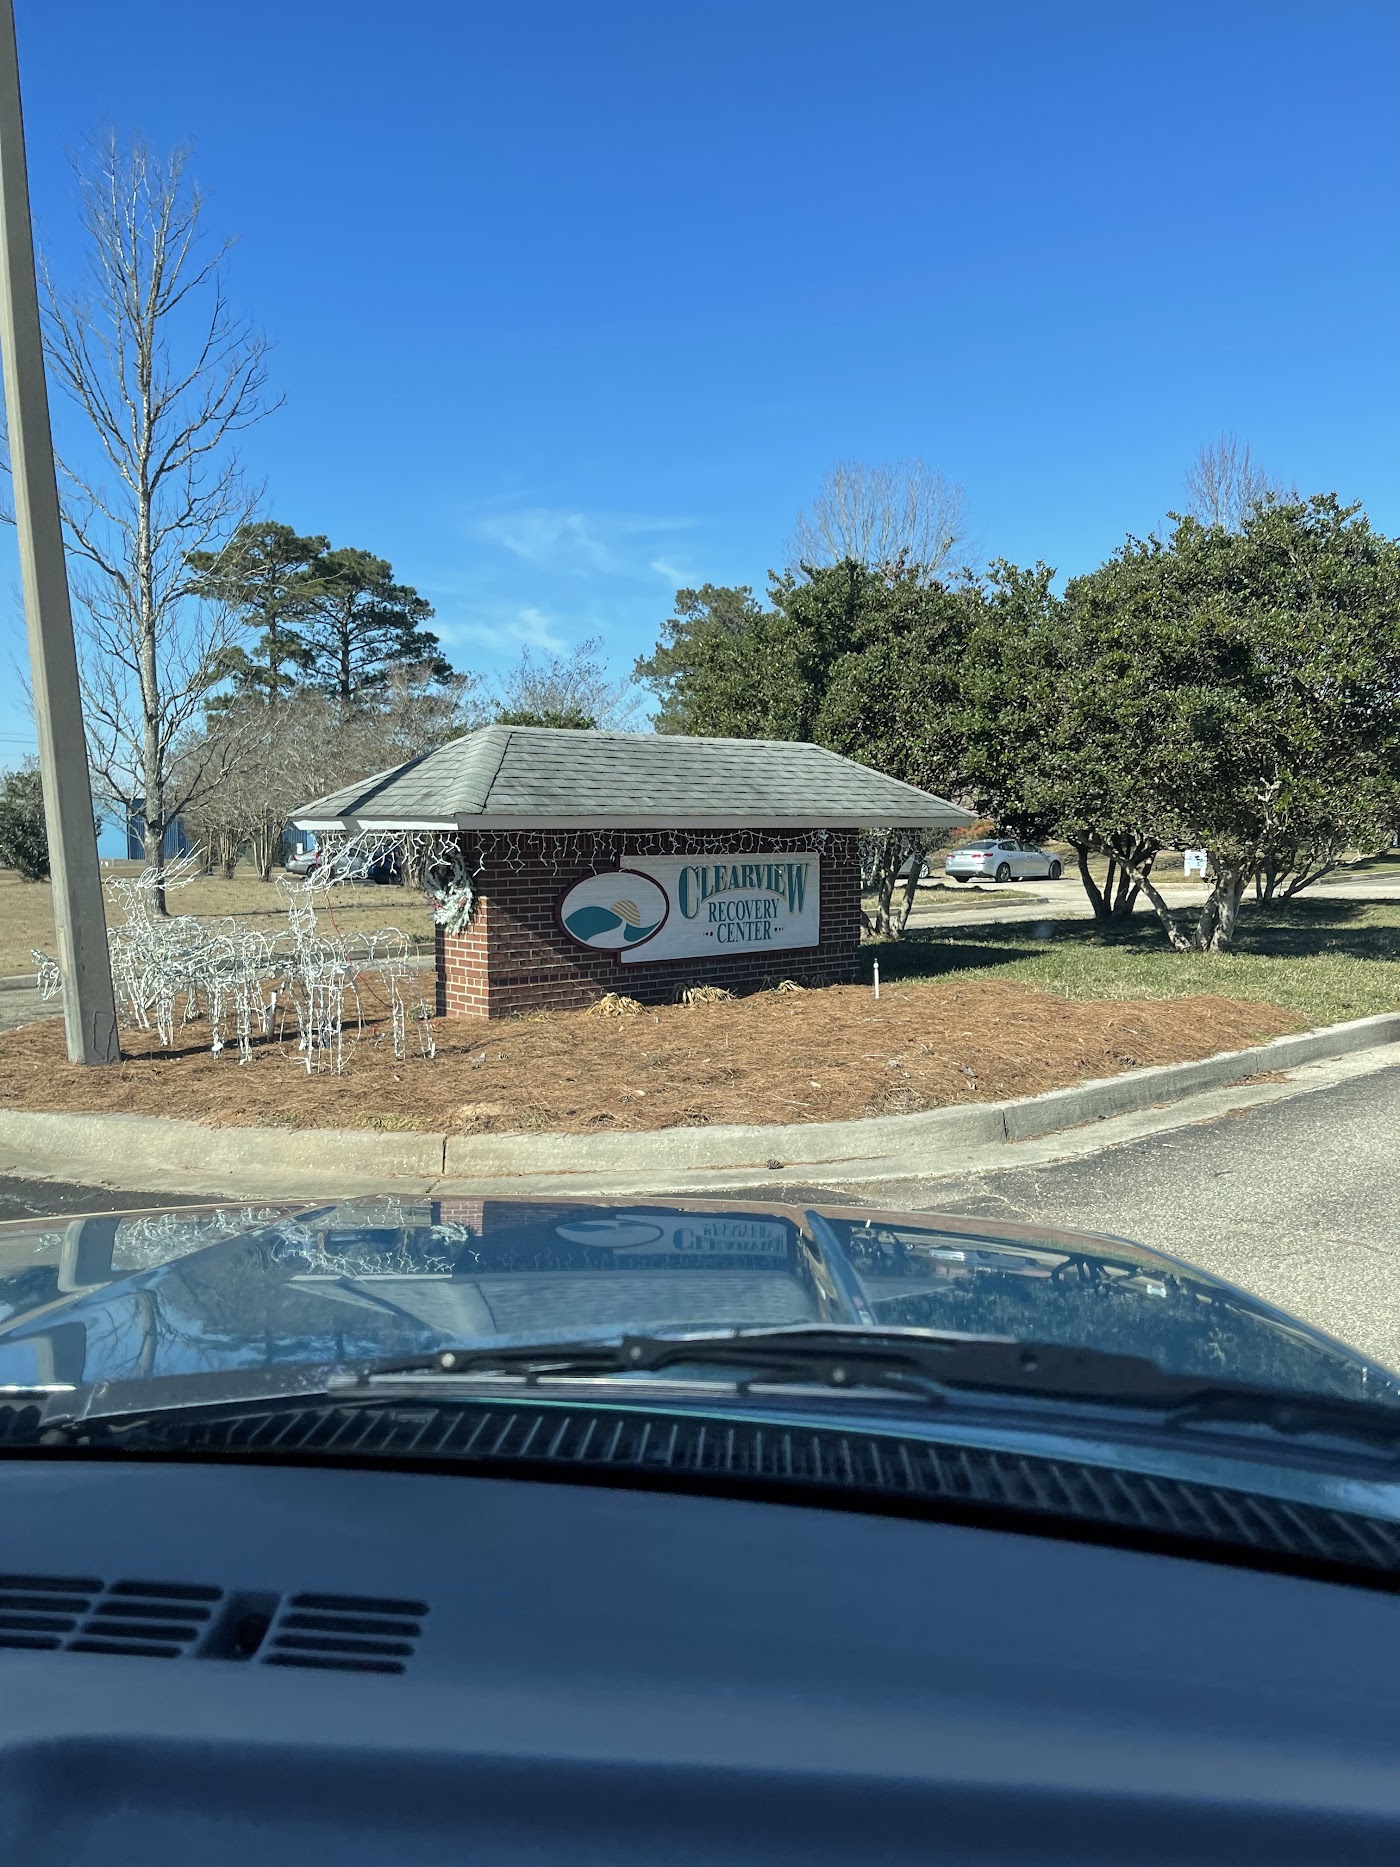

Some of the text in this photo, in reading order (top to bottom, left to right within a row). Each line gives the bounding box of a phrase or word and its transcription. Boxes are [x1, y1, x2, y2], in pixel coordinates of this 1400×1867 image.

[678, 863, 811, 919] CLEARVIEW
[708, 899, 779, 922] RECOVERY
[717, 921, 771, 943] CENTER
